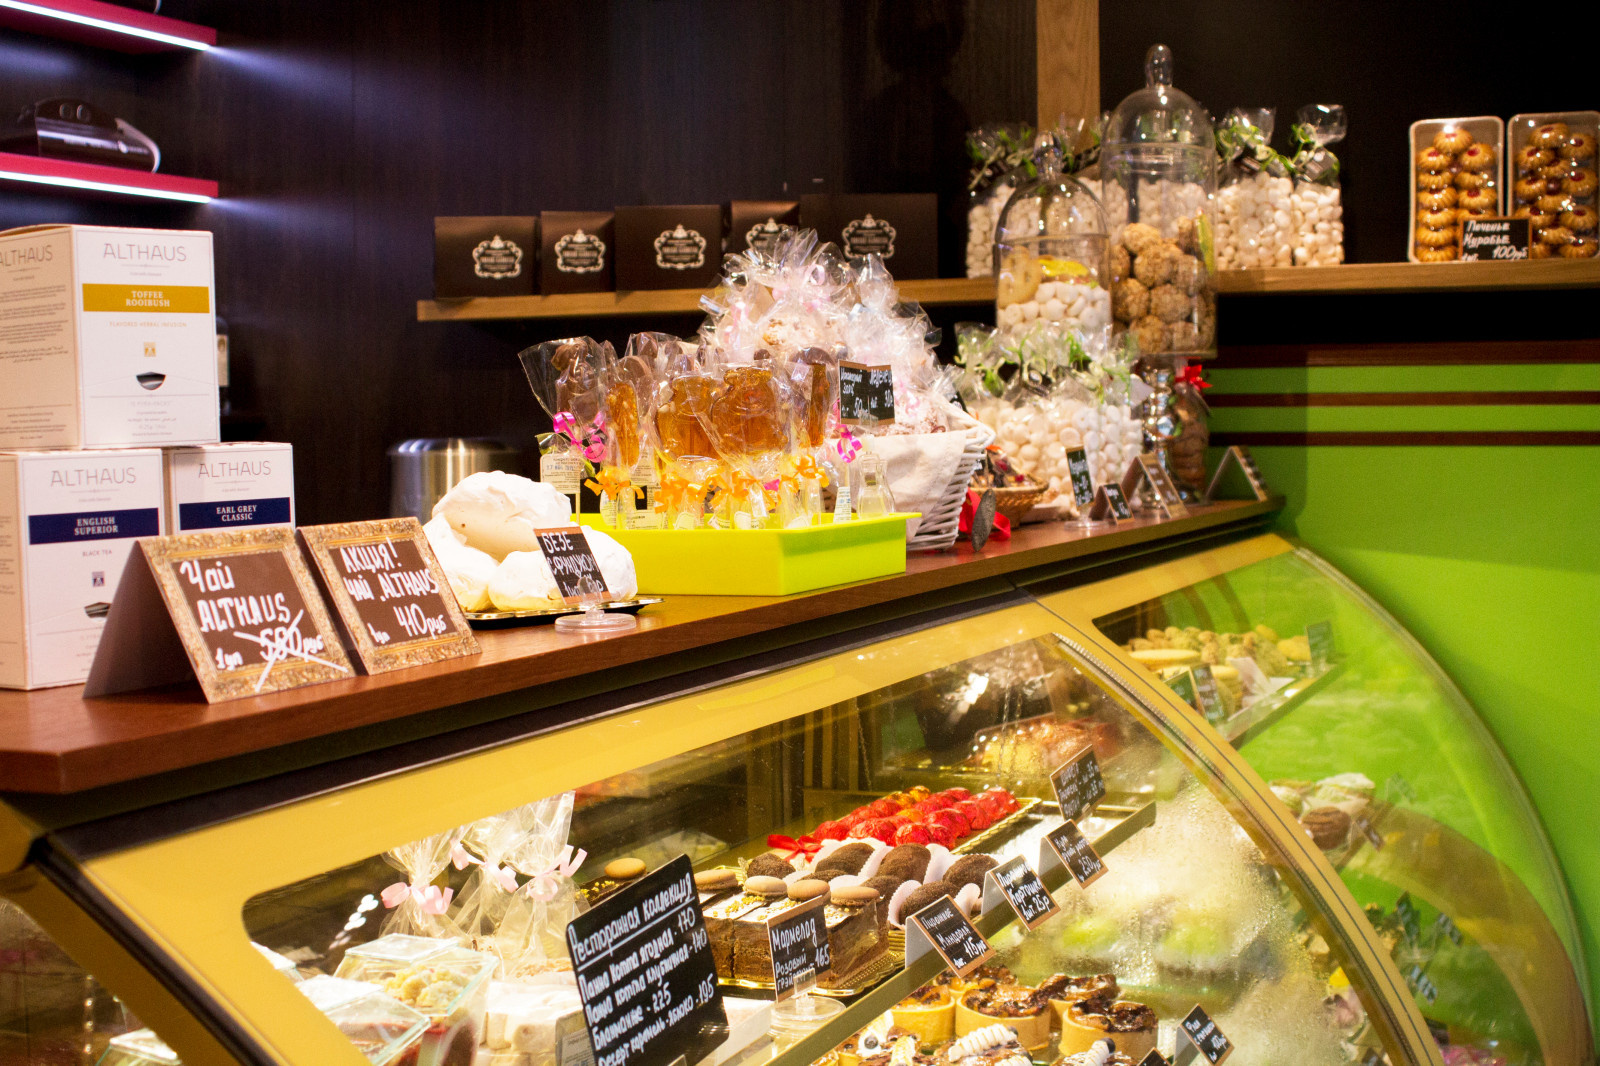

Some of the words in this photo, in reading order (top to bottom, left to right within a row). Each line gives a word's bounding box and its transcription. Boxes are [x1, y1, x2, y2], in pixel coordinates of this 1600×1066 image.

[103, 242, 188, 263] ALTHAUS
[125, 299, 170, 307] ROOIBUSH
[131, 290, 164, 299] TOFFEE
[50, 467, 137, 487] ALTHAUS
[199, 460, 272, 479] ALTHAUS
[216, 506, 236, 515] EARL
[237, 504, 258, 513] GREY
[221, 512, 253, 522] CLASSIC
[74, 525, 119, 536] SUPERIOR
[76, 516, 116, 527] ENGLISH
[180, 559, 236, 593] Чай
[197, 592, 291, 632] ALTHAUS
[567, 906, 640, 966] Ресторанная
[771, 918, 818, 955] Мармелад
[578, 971, 610, 1004] Панна
